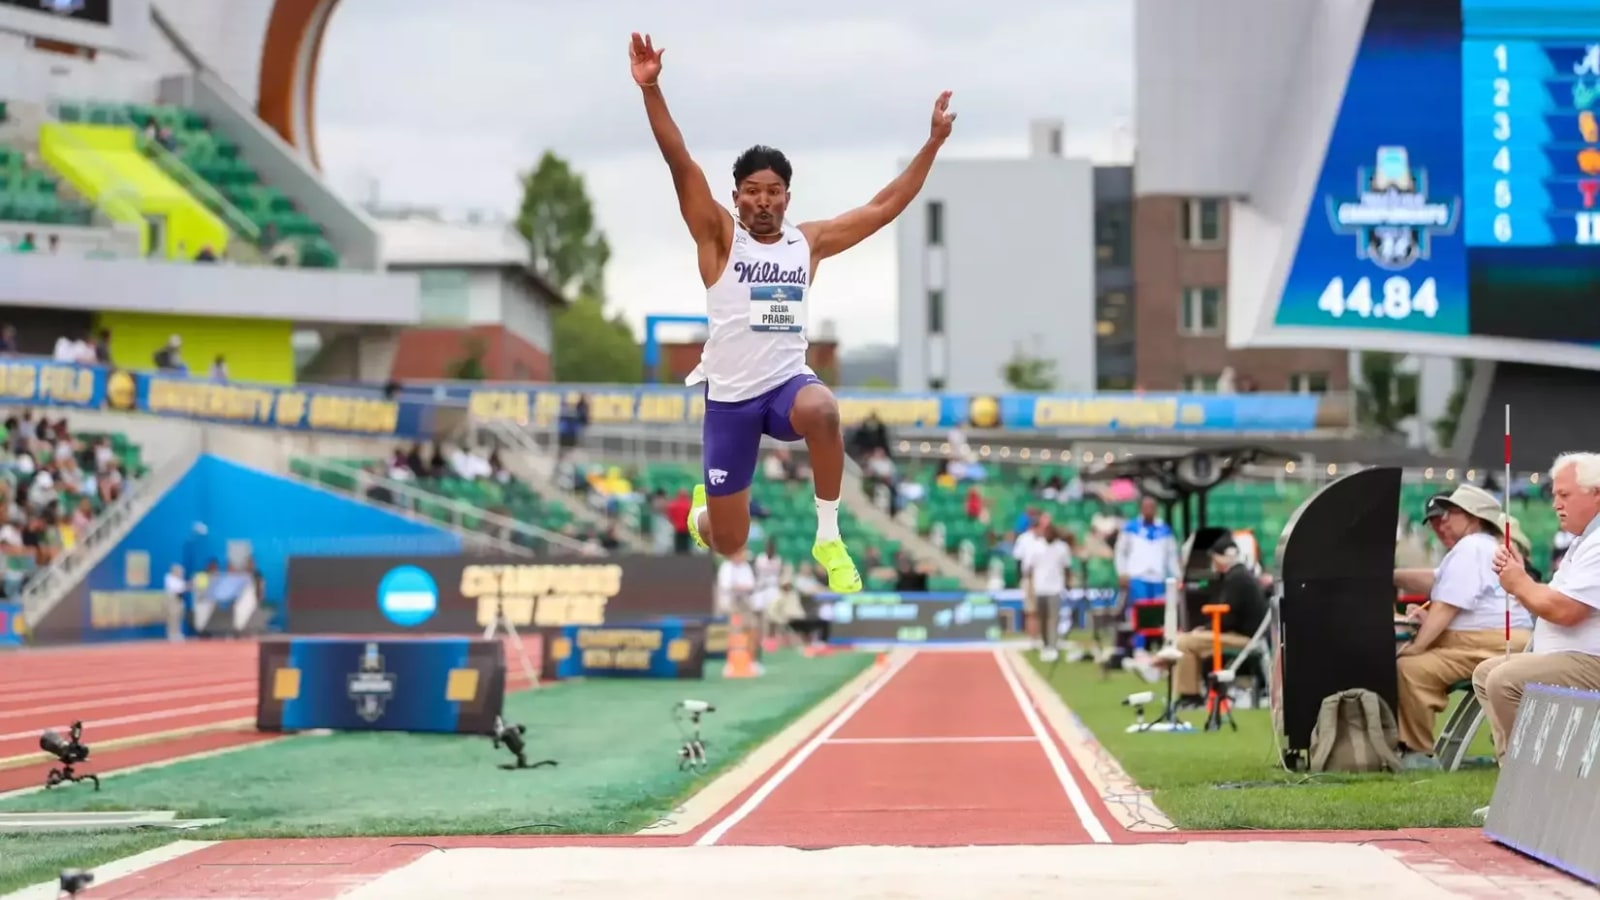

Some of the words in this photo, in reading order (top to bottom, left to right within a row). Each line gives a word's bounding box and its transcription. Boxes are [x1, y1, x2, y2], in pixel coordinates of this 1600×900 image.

[1493, 44, 1508, 73] 1
[1493, 77, 1510, 107] 2
[1493, 111, 1511, 141] 3
[1492, 145, 1511, 174] 4
[1493, 212, 1512, 242] 6
[734, 261, 807, 285] Wildcats
[1317, 275, 1439, 319] 44.84
[762, 314, 795, 325] PRABHU
